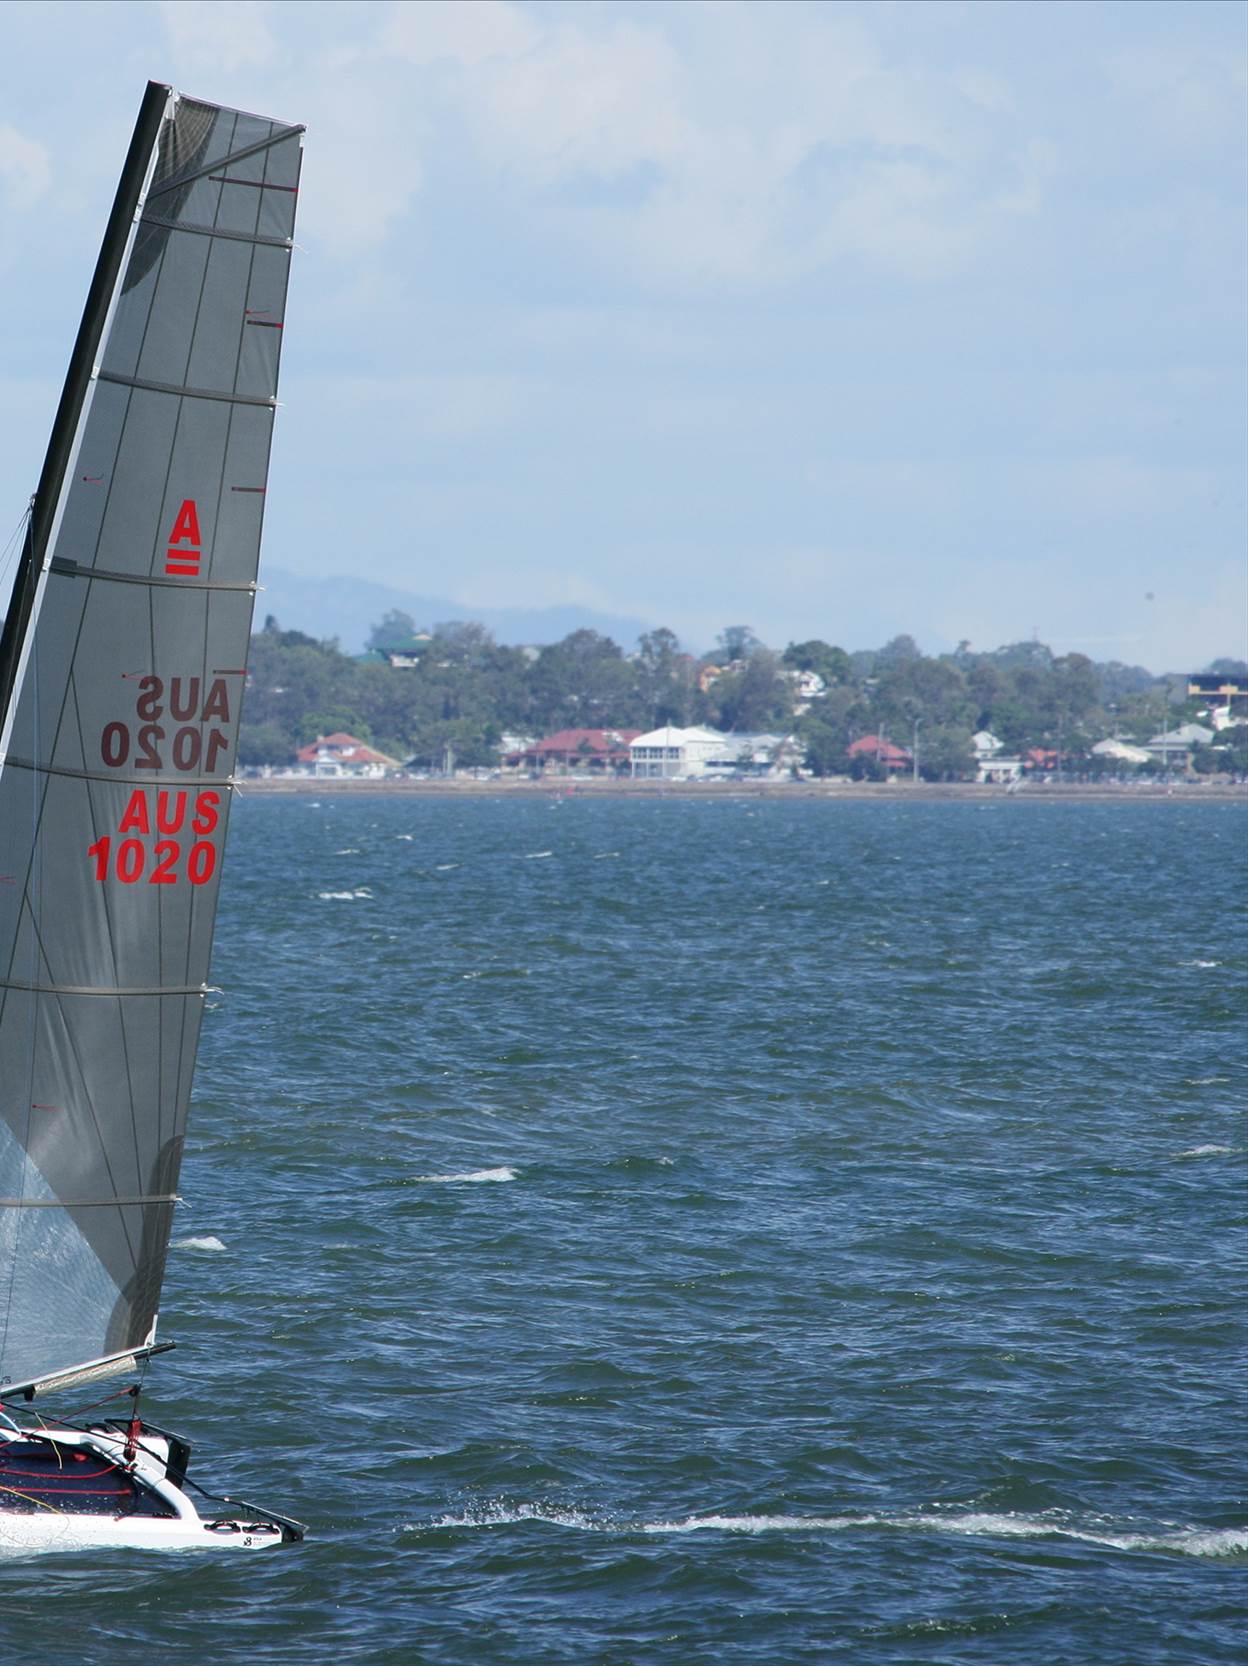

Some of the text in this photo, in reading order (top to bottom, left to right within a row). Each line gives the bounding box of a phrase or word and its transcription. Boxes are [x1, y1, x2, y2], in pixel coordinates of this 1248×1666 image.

[168, 500, 202, 546] A
[118, 789, 221, 835] AUS
[87, 836, 216, 885] 1020
